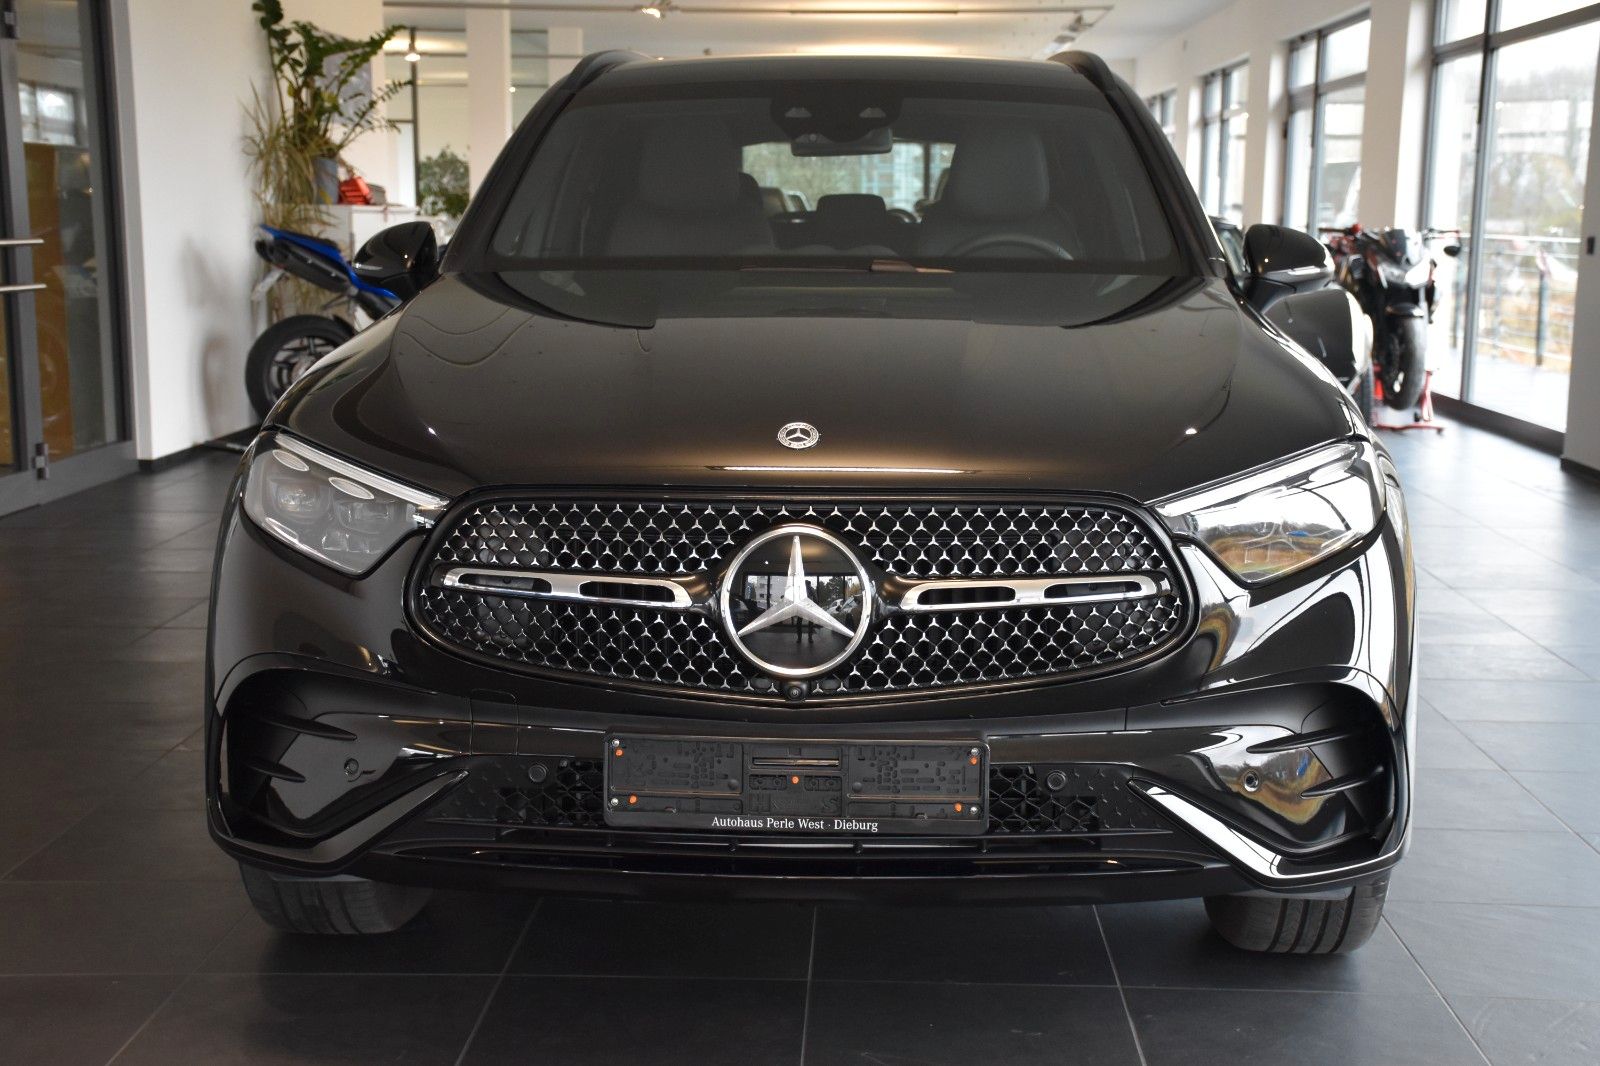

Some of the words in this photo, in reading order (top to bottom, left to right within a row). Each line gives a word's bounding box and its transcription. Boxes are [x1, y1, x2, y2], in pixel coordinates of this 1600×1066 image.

[711, 816, 763, 828] Autohaus
[766, 817, 795, 829] Perle
[797, 818, 825, 829] West
[834, 819, 878, 832] Dieburg
